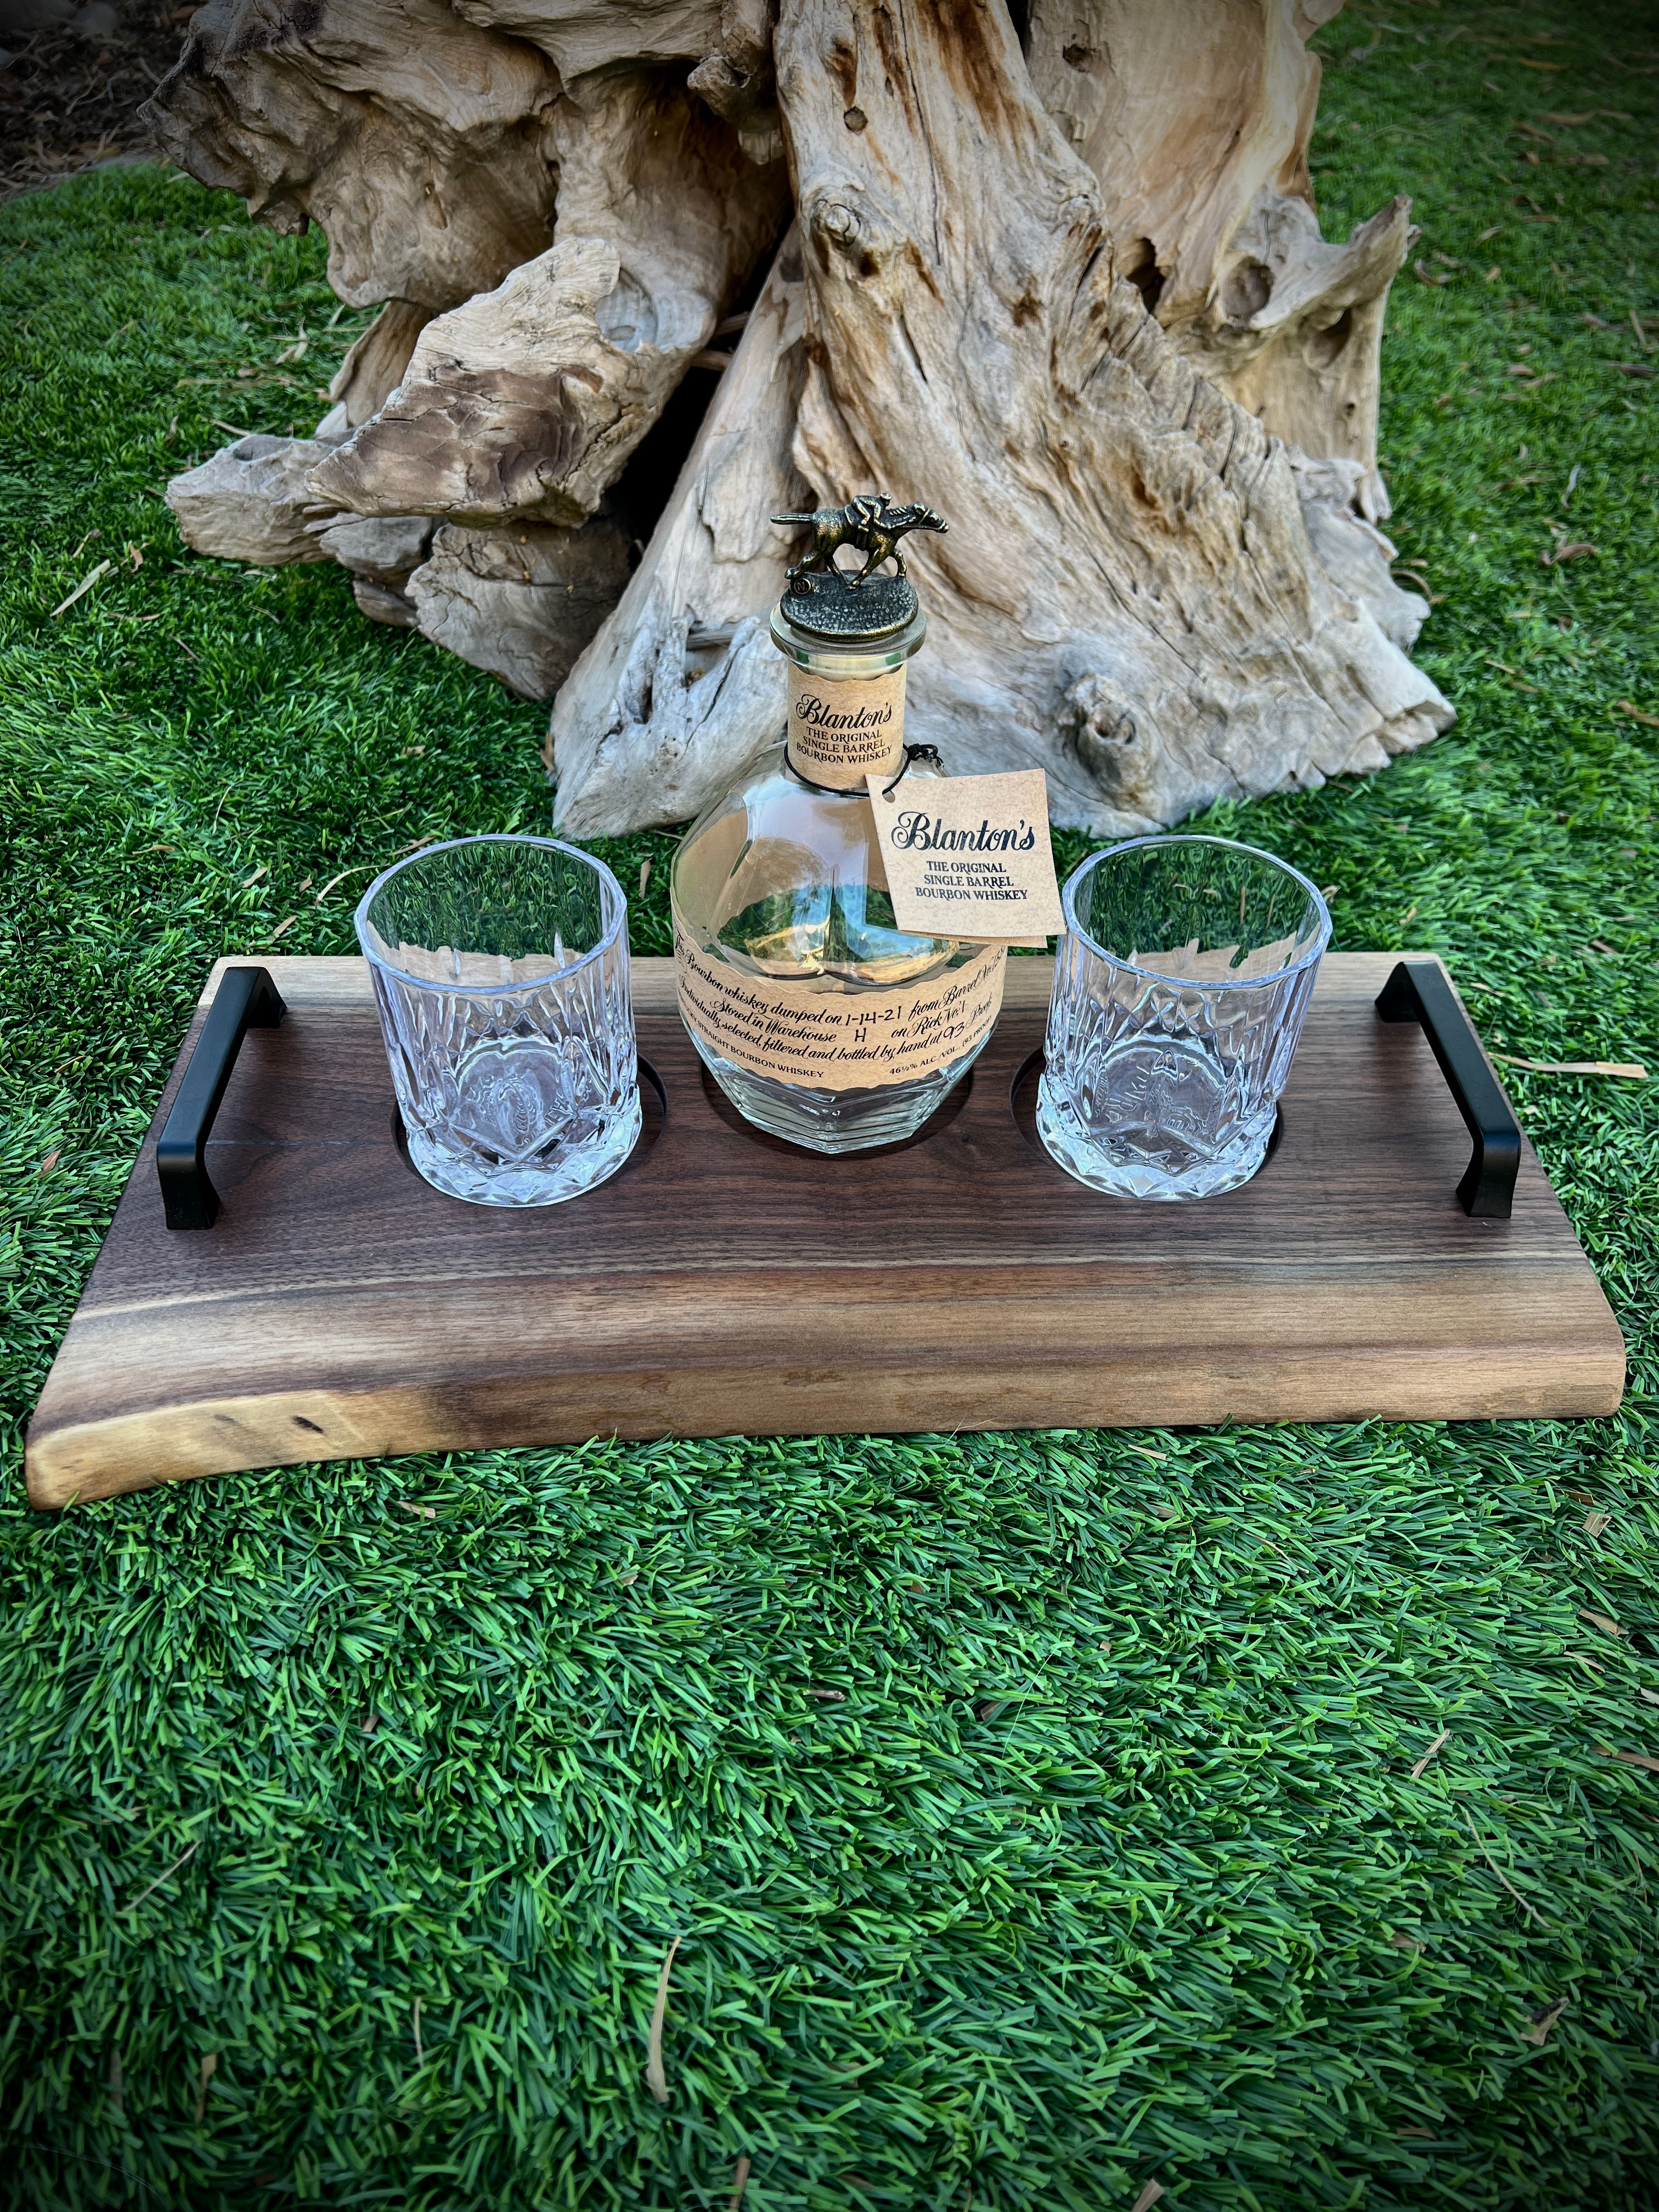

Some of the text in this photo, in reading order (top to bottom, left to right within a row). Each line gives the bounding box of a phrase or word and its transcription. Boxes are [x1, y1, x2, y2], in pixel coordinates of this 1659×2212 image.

[796, 694, 892, 729] Blanton's
[803, 736, 885, 754] SINGLE BARREL
[806, 726, 882, 744] THE ORIGINAL
[797, 743, 892, 764] BOURBON WHISKEY
[891, 811, 1035, 851] Blanton's
[924, 874, 1014, 889] SINGLE BARREL
[927, 861, 1006, 875] THE ORIGINAL
[915, 887, 1028, 900] BOURBON WHISKEY
[685, 949, 723, 992] Bourbon
[724, 986, 769, 1015] whiskey
[770, 1002, 827, 1024] dumped
[825, 1015, 842, 1026] on
[845, 1006, 901, 1026] 1-14-21
[909, 1000, 939, 1022] from
[938, 969, 981, 1009] Barrel
[679, 973, 722, 1030] Individually
[762, 1036, 810, 1059] filtered
[808, 1047, 838, 1062] and
[834, 1045, 881, 1060] bottled
[879, 1044, 896, 1062] by
[896, 1032, 933, 1055] hand
[929, 1030, 943, 1045] at
[943, 1022, 966, 1040] 93
[710, 997, 754, 1027] Stored
[753, 1015, 764, 1030] in
[761, 1014, 837, 1042] Warehouse
[854, 1028, 867, 1042] H
[891, 1028, 907, 1039] on
[906, 1011, 943, 1039] Rick
[697, 1020, 824, 1078] STRAIGHT BOURBON WHISKEY
